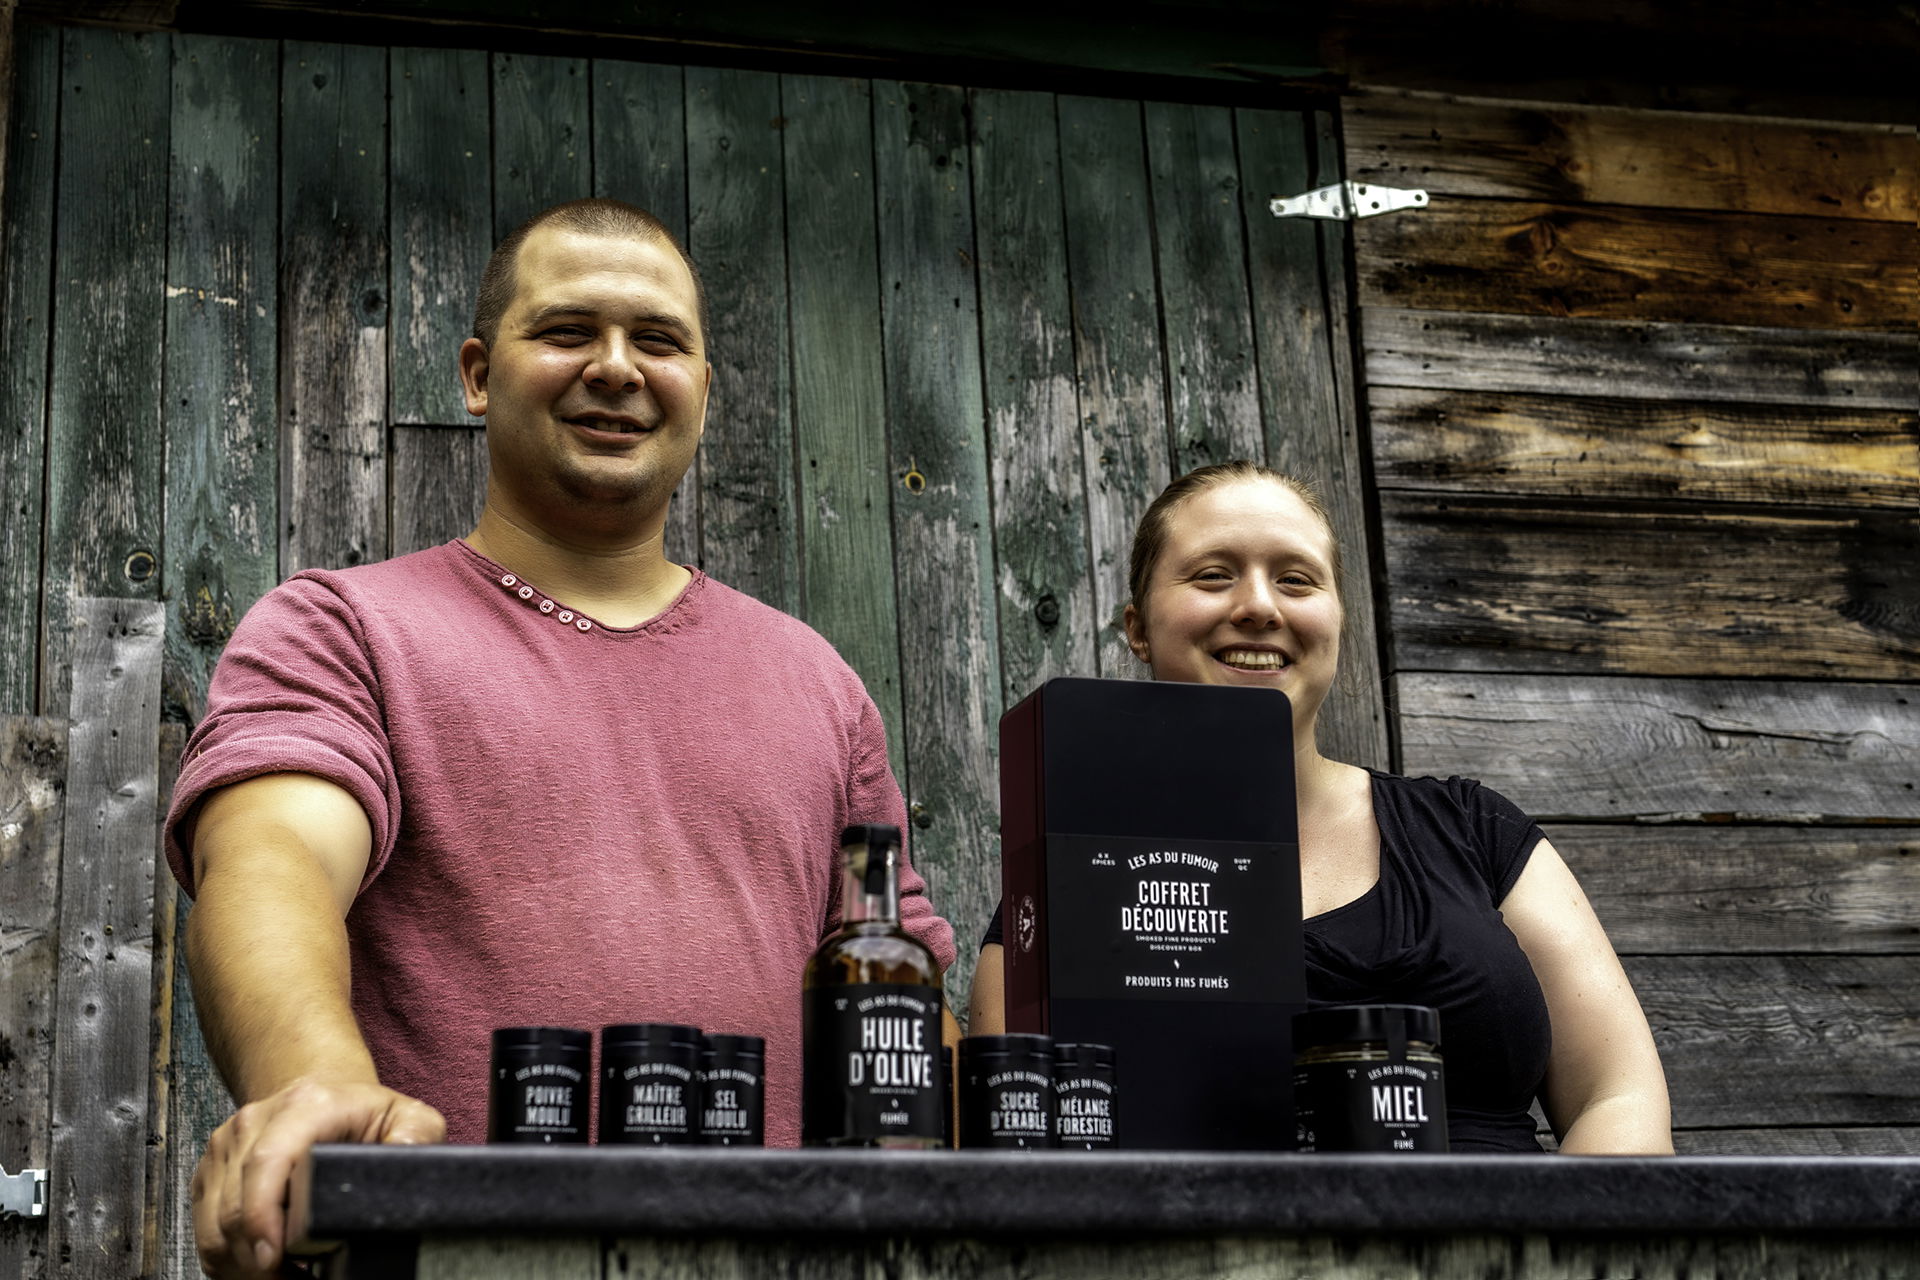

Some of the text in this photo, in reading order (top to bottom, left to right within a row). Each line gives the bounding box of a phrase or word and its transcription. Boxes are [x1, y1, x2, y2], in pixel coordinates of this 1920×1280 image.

[1127, 851, 1220, 874] LES AS DU FUMOIR
[1138, 880, 1210, 906] COFFRET
[1121, 903, 1229, 934] DÉCOUVERTE
[1164, 935, 1179, 943] FINE
[1181, 936, 1216, 944] PRODUCTS
[1125, 975, 1229, 989] PRODUITS FINS FUMÉS
[861, 1017, 924, 1051] HUILE
[525, 1085, 572, 1106] POIVRE
[633, 1082, 682, 1105] MAÎTRE
[714, 1090, 738, 1109] SEL
[1000, 1091, 1040, 1111] SUCRE
[1371, 1085, 1429, 1122] MIEL
[525, 1106, 570, 1126] MOULU
[626, 1105, 687, 1125] GRILLEUR
[1060, 1096, 1110, 1117] MÉLANGE
[704, 1109, 747, 1128] MOULU
[1056, 1117, 1113, 1136] FORESTIER
[1394, 1138, 1414, 1150] FUMÉ
